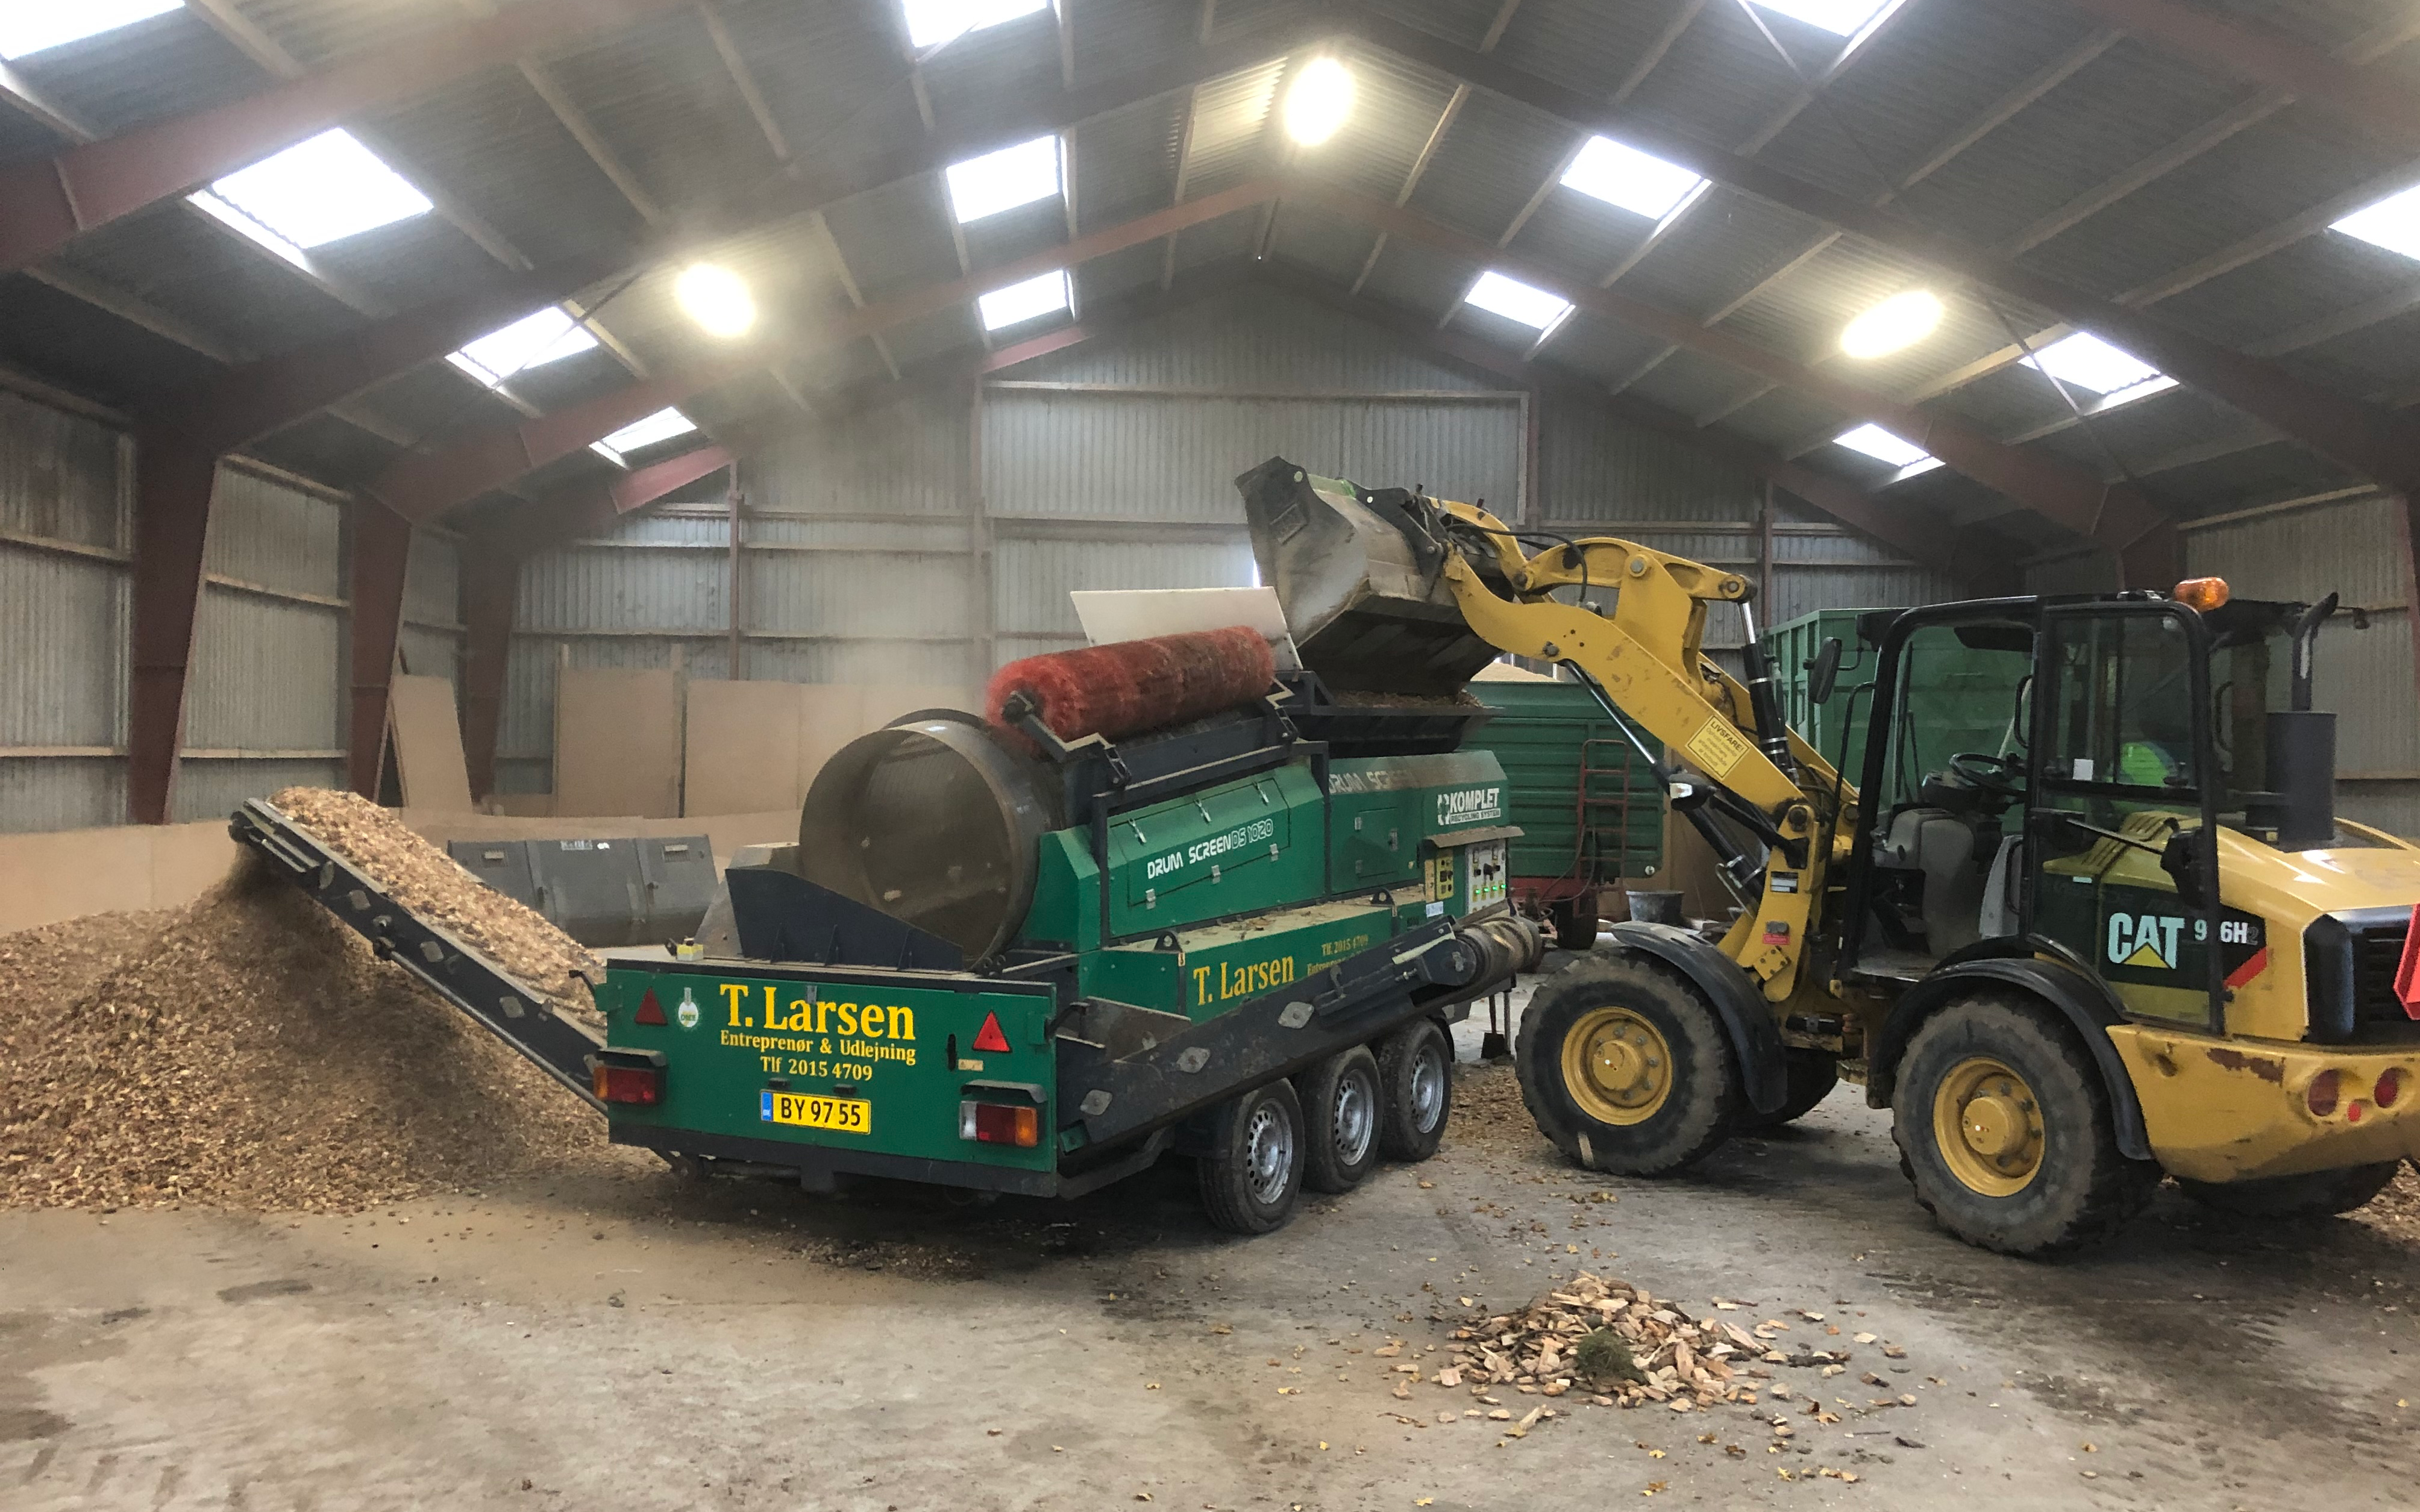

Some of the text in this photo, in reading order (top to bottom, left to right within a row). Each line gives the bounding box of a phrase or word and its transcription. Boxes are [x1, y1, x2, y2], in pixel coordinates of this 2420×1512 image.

[1710, 721, 1744, 752] LIVSFARE!
[1450, 788, 1499, 813] KOMPLET
[1147, 852, 1183, 879] DRUM
[1247, 818, 1273, 843] 1020
[2108, 912, 2185, 970] CAT
[1193, 955, 1294, 1005] T. Larsen
[719, 984, 916, 1040] T. Larsen
[720, 1029, 916, 1066] Entreprenør & Udlejning
[760, 1055, 873, 1081] Tlf 2015 4709
[781, 1097, 861, 1126] BY 97 55
